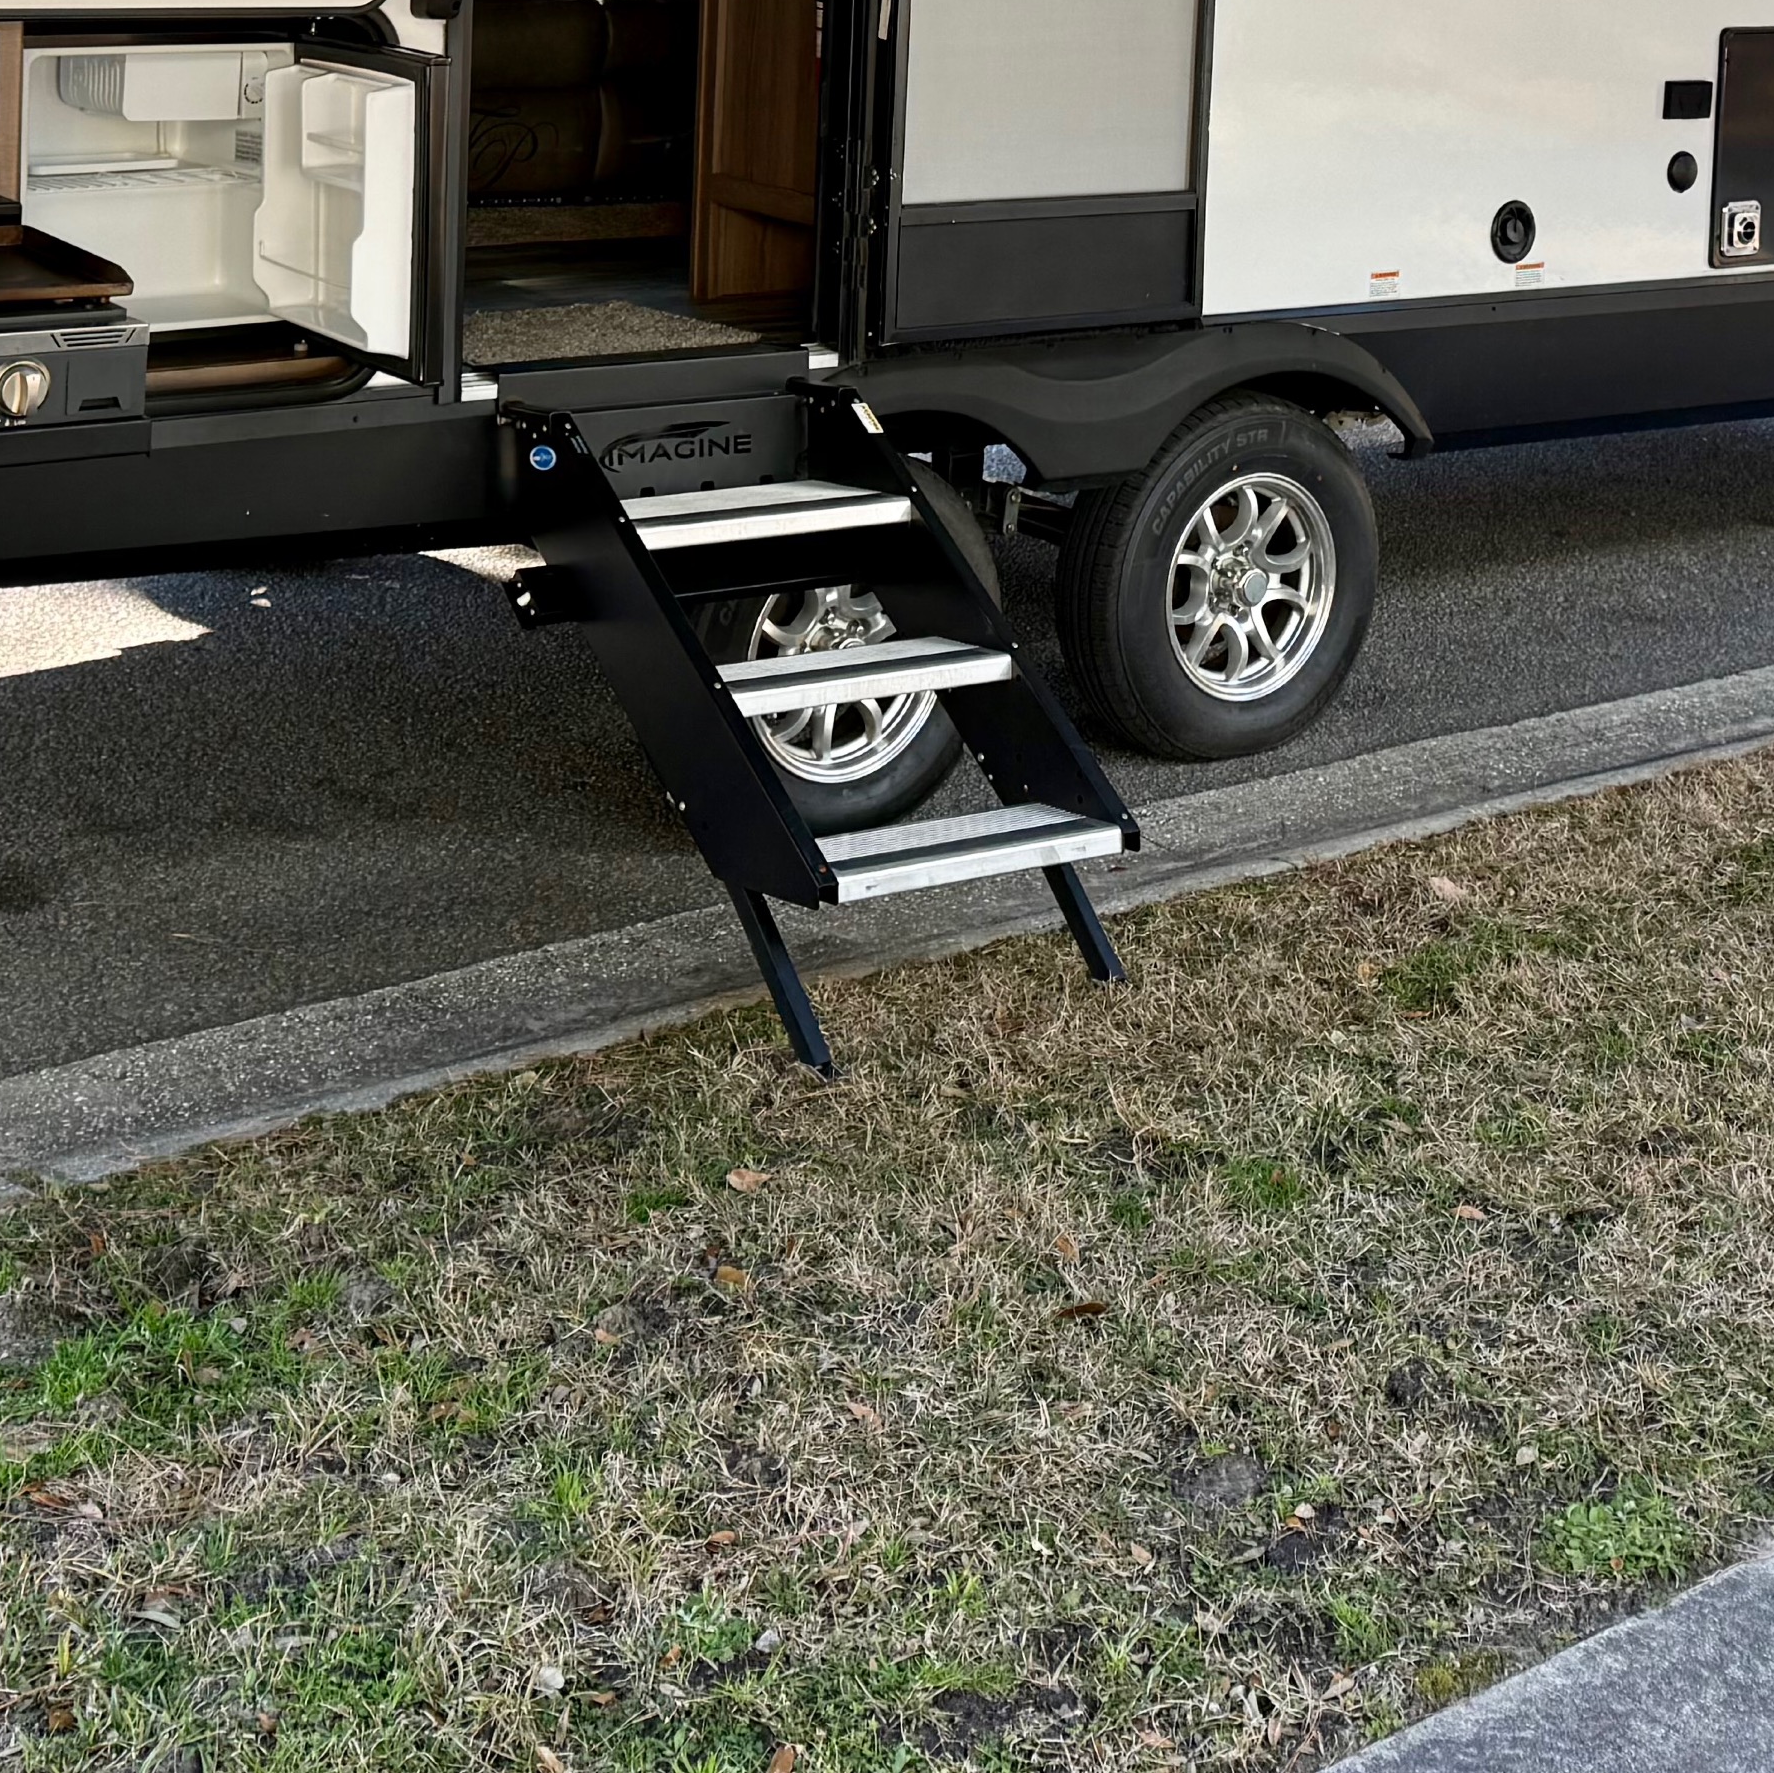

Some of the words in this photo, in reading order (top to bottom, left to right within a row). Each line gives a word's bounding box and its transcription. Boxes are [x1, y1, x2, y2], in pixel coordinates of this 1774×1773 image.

[608, 434, 752, 467] IMAGINE
[1152, 436, 1231, 535] CAPABILITY
[1236, 429, 1269, 447] STR
